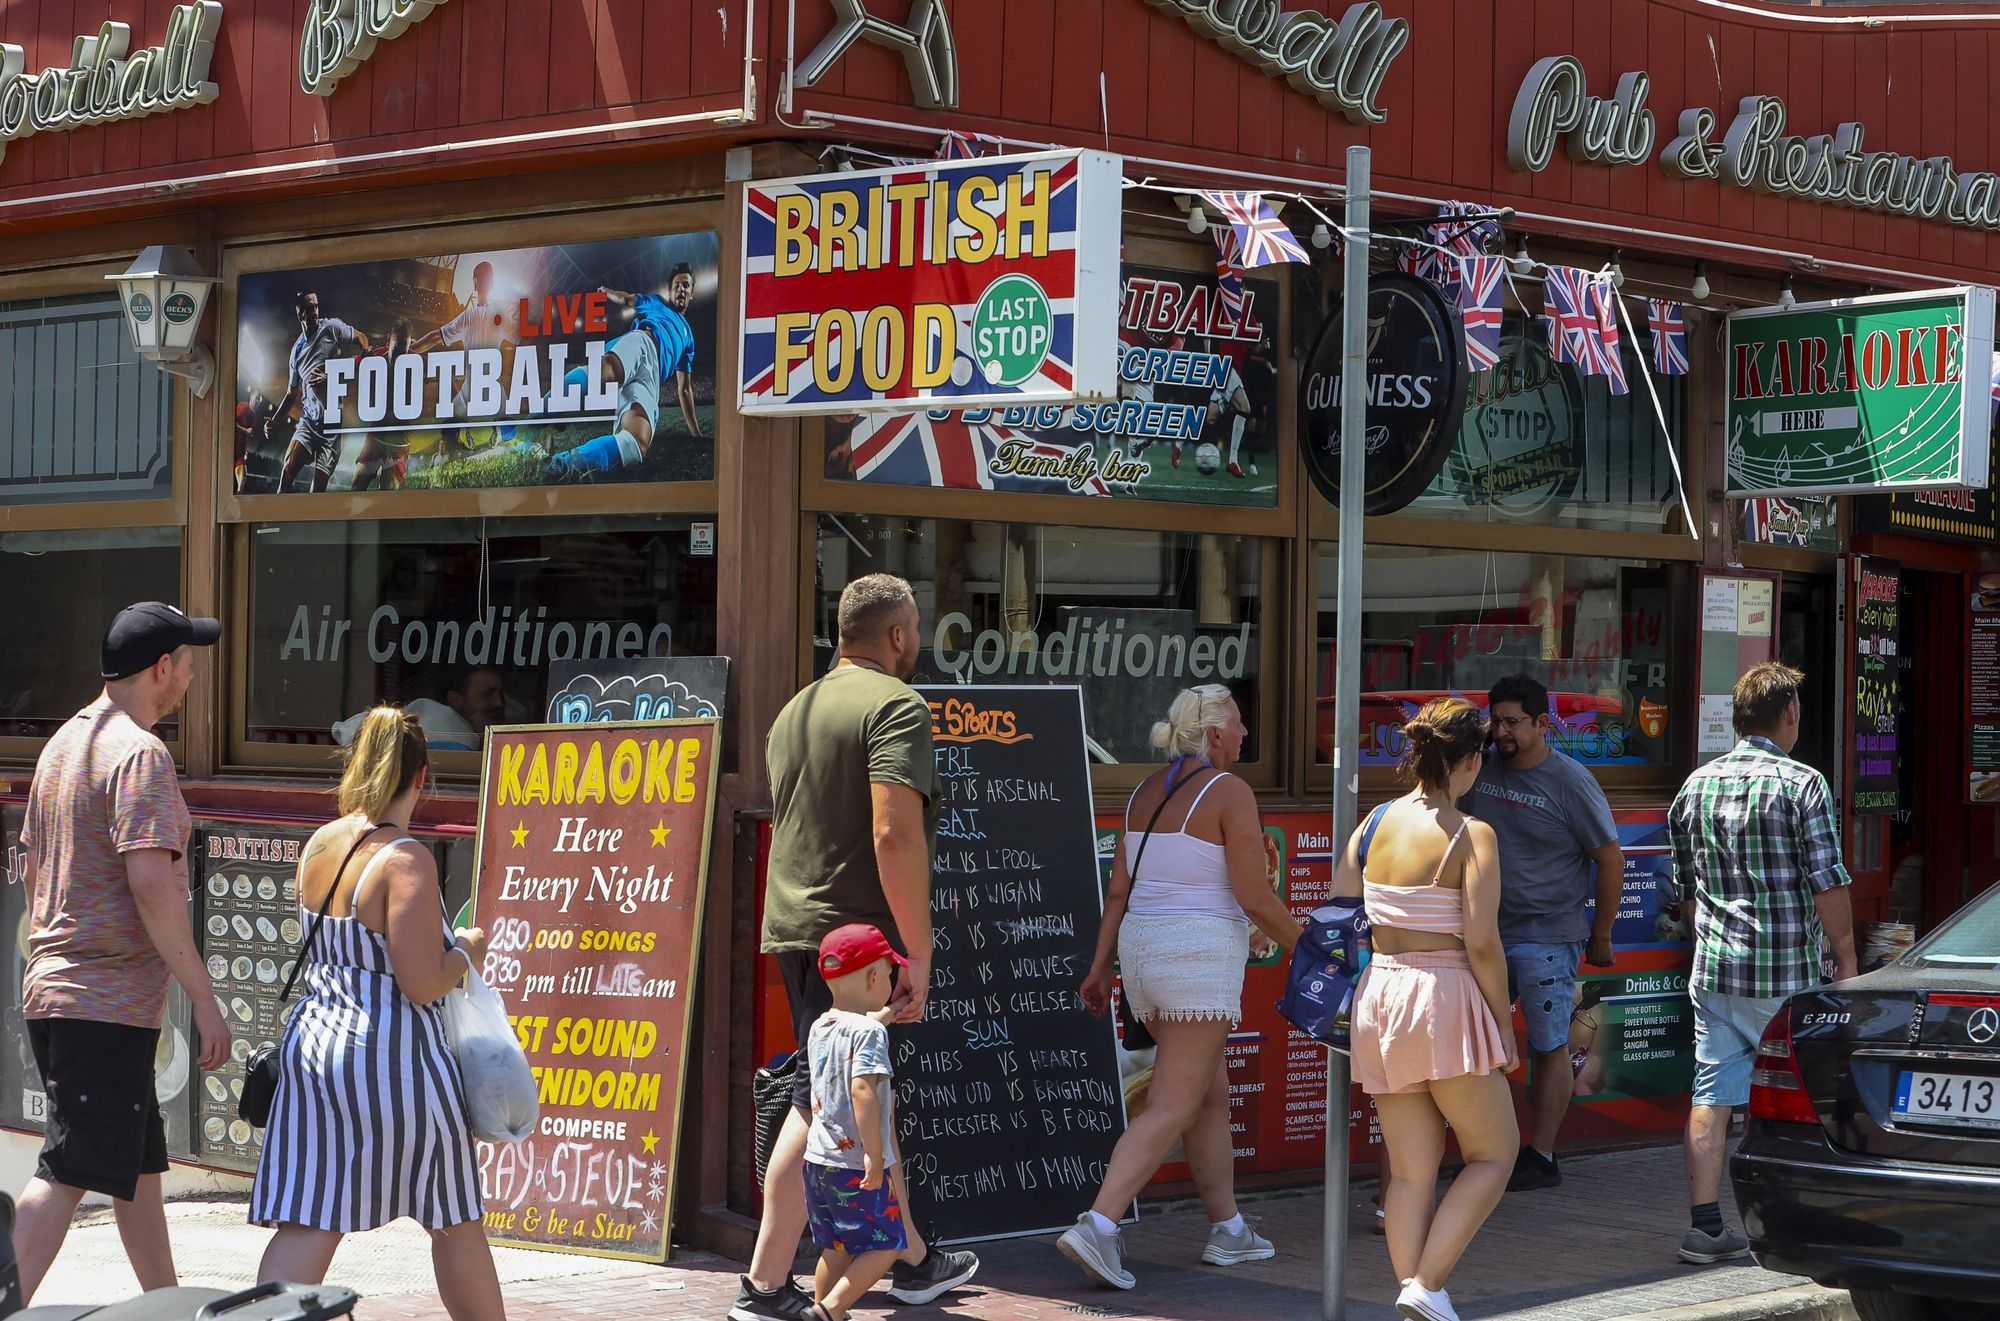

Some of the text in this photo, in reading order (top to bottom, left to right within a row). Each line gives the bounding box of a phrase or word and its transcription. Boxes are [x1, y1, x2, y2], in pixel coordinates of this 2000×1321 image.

[0, 2, 222, 138] ootball
[1508, 55, 2000, 230] Pub & Restaura
[774, 170, 1051, 278] BRITISH
[519, 291, 607, 337] LIVE
[988, 297, 1038, 322] LAST
[1125, 277, 1264, 342] TBALL
[772, 302, 956, 396] FOOD
[978, 324, 1047, 358] STOP
[1733, 325, 1963, 400] KARAOKE
[323, 341, 619, 424] FOOTBALL
[1306, 372, 1432, 411] GUINESS
[1071, 399, 1207, 440] SCREEN
[1485, 408, 1548, 441] STOP
[1781, 409, 1825, 431] HERE
[990, 438, 1150, 489] Family bar
[1481, 453, 1563, 492] SPORTS BAR
[1860, 571, 1898, 607] KARAOKE
[280, 604, 351, 662] Air
[933, 611, 1257, 680] Conditioned
[1857, 676, 1882, 726] Ray
[1876, 713, 1896, 733] STEVE
[1549, 722, 1626, 758] NGS
[497, 737, 700, 806] KARAOKE
[934, 746, 973, 772] FRI
[986, 778, 1061, 803] ARSENAL
[552, 817, 623, 853] Here
[1297, 832, 1329, 849] Main
[208, 836, 300, 862] BRITISH
[959, 851, 976, 873] VS
[1291, 868, 1311, 877] CHIPS
[1627, 860, 1636, 869] PIE
[498, 865, 673, 914] Every Night
[965, 884, 979, 909] VS
[987, 878, 1042, 912] WIGAN
[1291, 882, 1322, 892] SAUSAGE,
[1291, 892, 1319, 901] BEANS &
[1623, 881, 1657, 890] OLATE CAKE
[1290, 907, 1296, 916] A
[1622, 910, 1644, 919] COFFEE
[579, 930, 657, 952] SONGS
[967, 922, 986, 950] VS
[521, 973, 555, 1001] pm
[561, 966, 593, 994] till
[643, 977, 676, 998] am
[978, 955, 1074, 985] VS WOLVES
[1625, 976, 1687, 993] Drinks & Co
[919, 998, 976, 1023] VERTON
[984, 992, 1001, 1015] VS
[1624, 1005, 1662, 1015] WINE BOTTLE
[1624, 1015, 1680, 1027] SWEET WINE BOTTLE
[552, 1017, 658, 1059] SOUND
[962, 1017, 1009, 1042] SUN
[1623, 1027, 1666, 1039] GLASS OF WINE
[1242, 1045, 1259, 1054] HAM
[1287, 1050, 1317, 1060] LASAGNE
[1623, 1040, 1649, 1050] SANGRÍA
[1623, 1050, 1676, 1062] GLASS OF SANGRIA
[920, 1051, 963, 1072] HIBS
[998, 1050, 1018, 1077] VS
[1029, 1050, 1088, 1071] HEARTS
[1229, 1059, 1246, 1068] LOIN
[1287, 1071, 1323, 1081] COD FISH &
[530, 1066, 661, 1111] ENIDORM
[918, 1078, 1115, 1109] MAN UTD VS BRIGHTON
[1239, 1083, 1266, 1093] BREAST
[1899, 1077, 1994, 1113] E 3413
[1009, 1109, 1027, 1129] VS
[1285, 1112, 1327, 1125] SCAMPIS CHI
[1286, 1101, 1308, 1111] ONION
[541, 1116, 627, 1141] COMPERE
[1232, 1147, 1256, 1158] BREAD
[475, 1141, 535, 1209] RAY
[932, 1174, 970, 1202] WEST
[975, 1164, 1006, 1197] HAM
[1015, 1159, 1037, 1191] VS
[1041, 1155, 1087, 1191] MAN
[1089, 1160, 1110, 1185] CI
[522, 1206, 542, 1232] &
[546, 1208, 568, 1234] be
[572, 1218, 585, 1237] a
[591, 1212, 637, 1242] Star
